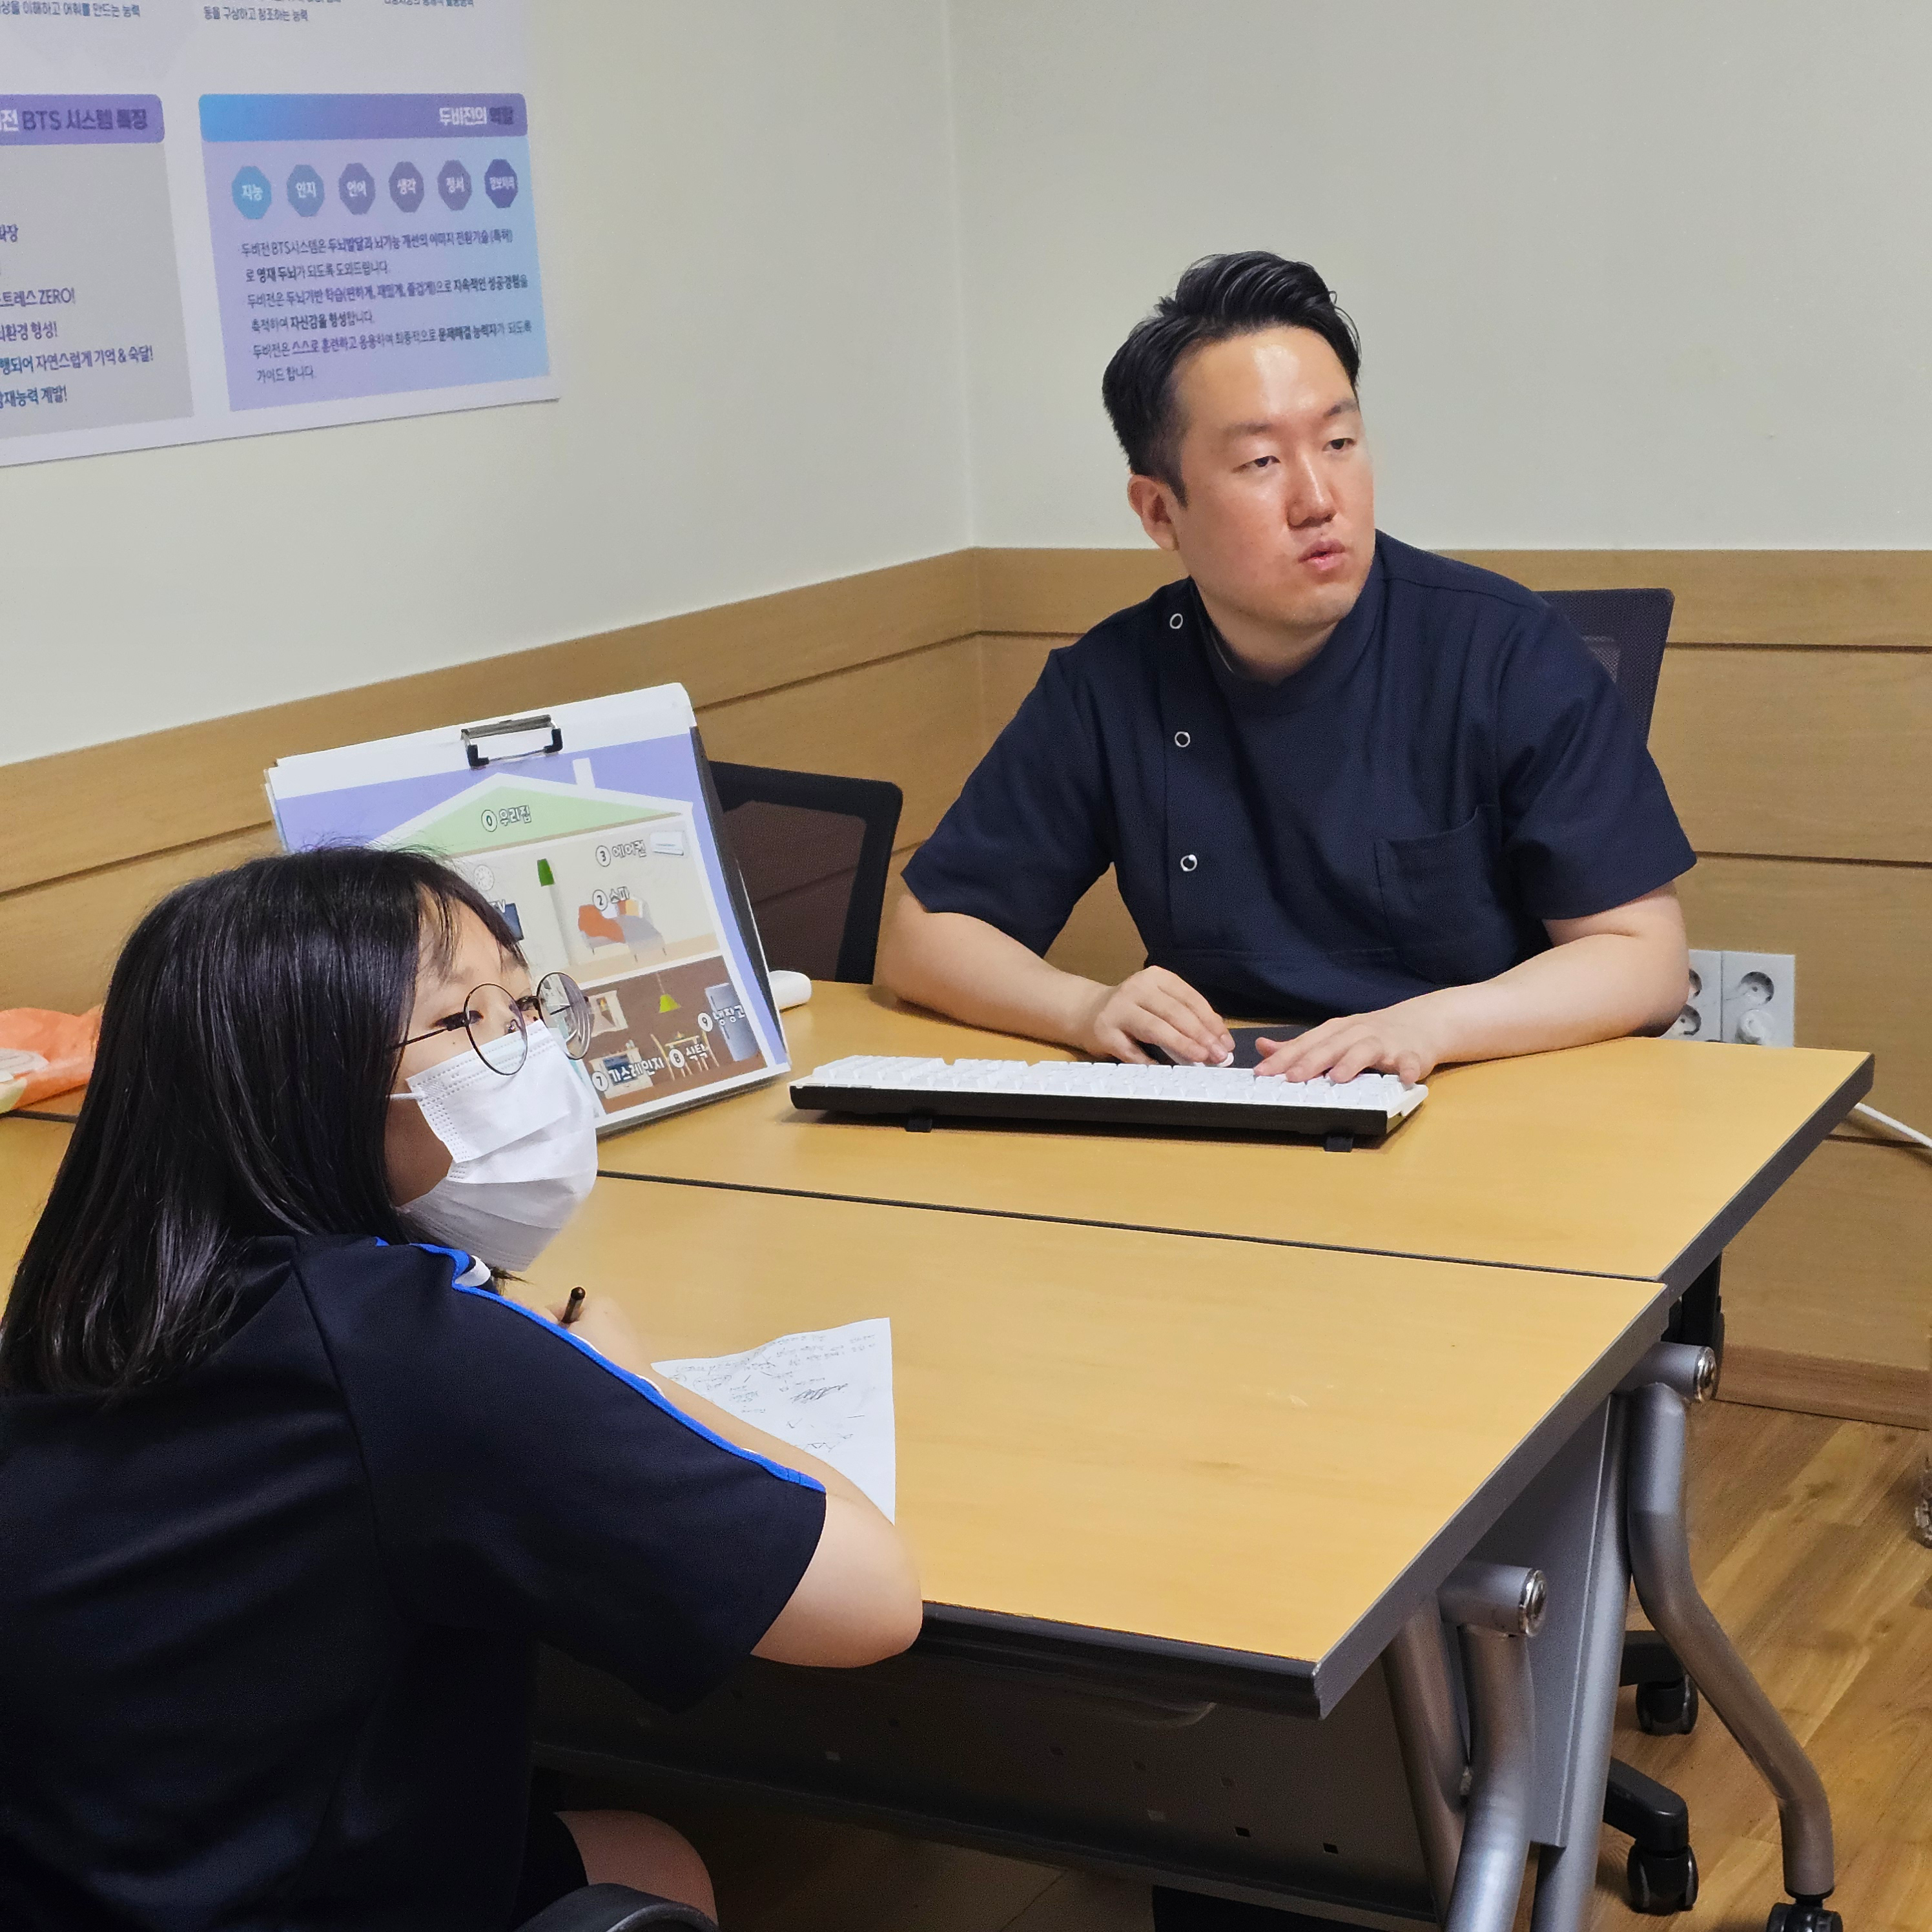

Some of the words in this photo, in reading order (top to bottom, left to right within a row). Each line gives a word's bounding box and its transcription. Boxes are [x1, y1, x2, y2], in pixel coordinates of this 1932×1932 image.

[23, 1, 61, 15] 이해하고
[92, 3, 120, 17] 만드는
[122, 4, 141, 18] 능력
[223, 6, 256, 21] 구상하고
[258, 8, 291, 21] 창조하는
[22, 110, 62, 130] BTS
[66, 108, 114, 130] 시스템
[439, 106, 487, 126] 두비전의
[296, 180, 316, 198] 인지
[347, 180, 367, 198] 언어
[246, 269, 255, 283] 로
[257, 267, 276, 283] 영재
[278, 265, 306, 282] 두뇌가
[0, 290, 37, 307] 트레스
[37, 287, 76, 305] ZERO!
[248, 291, 285, 309] 두비전은
[30, 320, 58, 340] 형성!
[291, 314, 327, 331] 자신감을
[35, 349, 94, 371] 자연스럽게
[94, 347, 118, 366] 기억
[118, 347, 127, 364] &
[128, 344, 154, 364] 숙달!
[253, 342, 291, 360] 두비전은
[292, 339, 320, 355] 스스로
[256, 367, 286, 384] 가이드
[40, 384, 68, 404] 개발!
[498, 805, 532, 827] 우리집
[712, 1004, 746, 1027] 냉장고
[608, 1056, 665, 1083] 가스레인지
